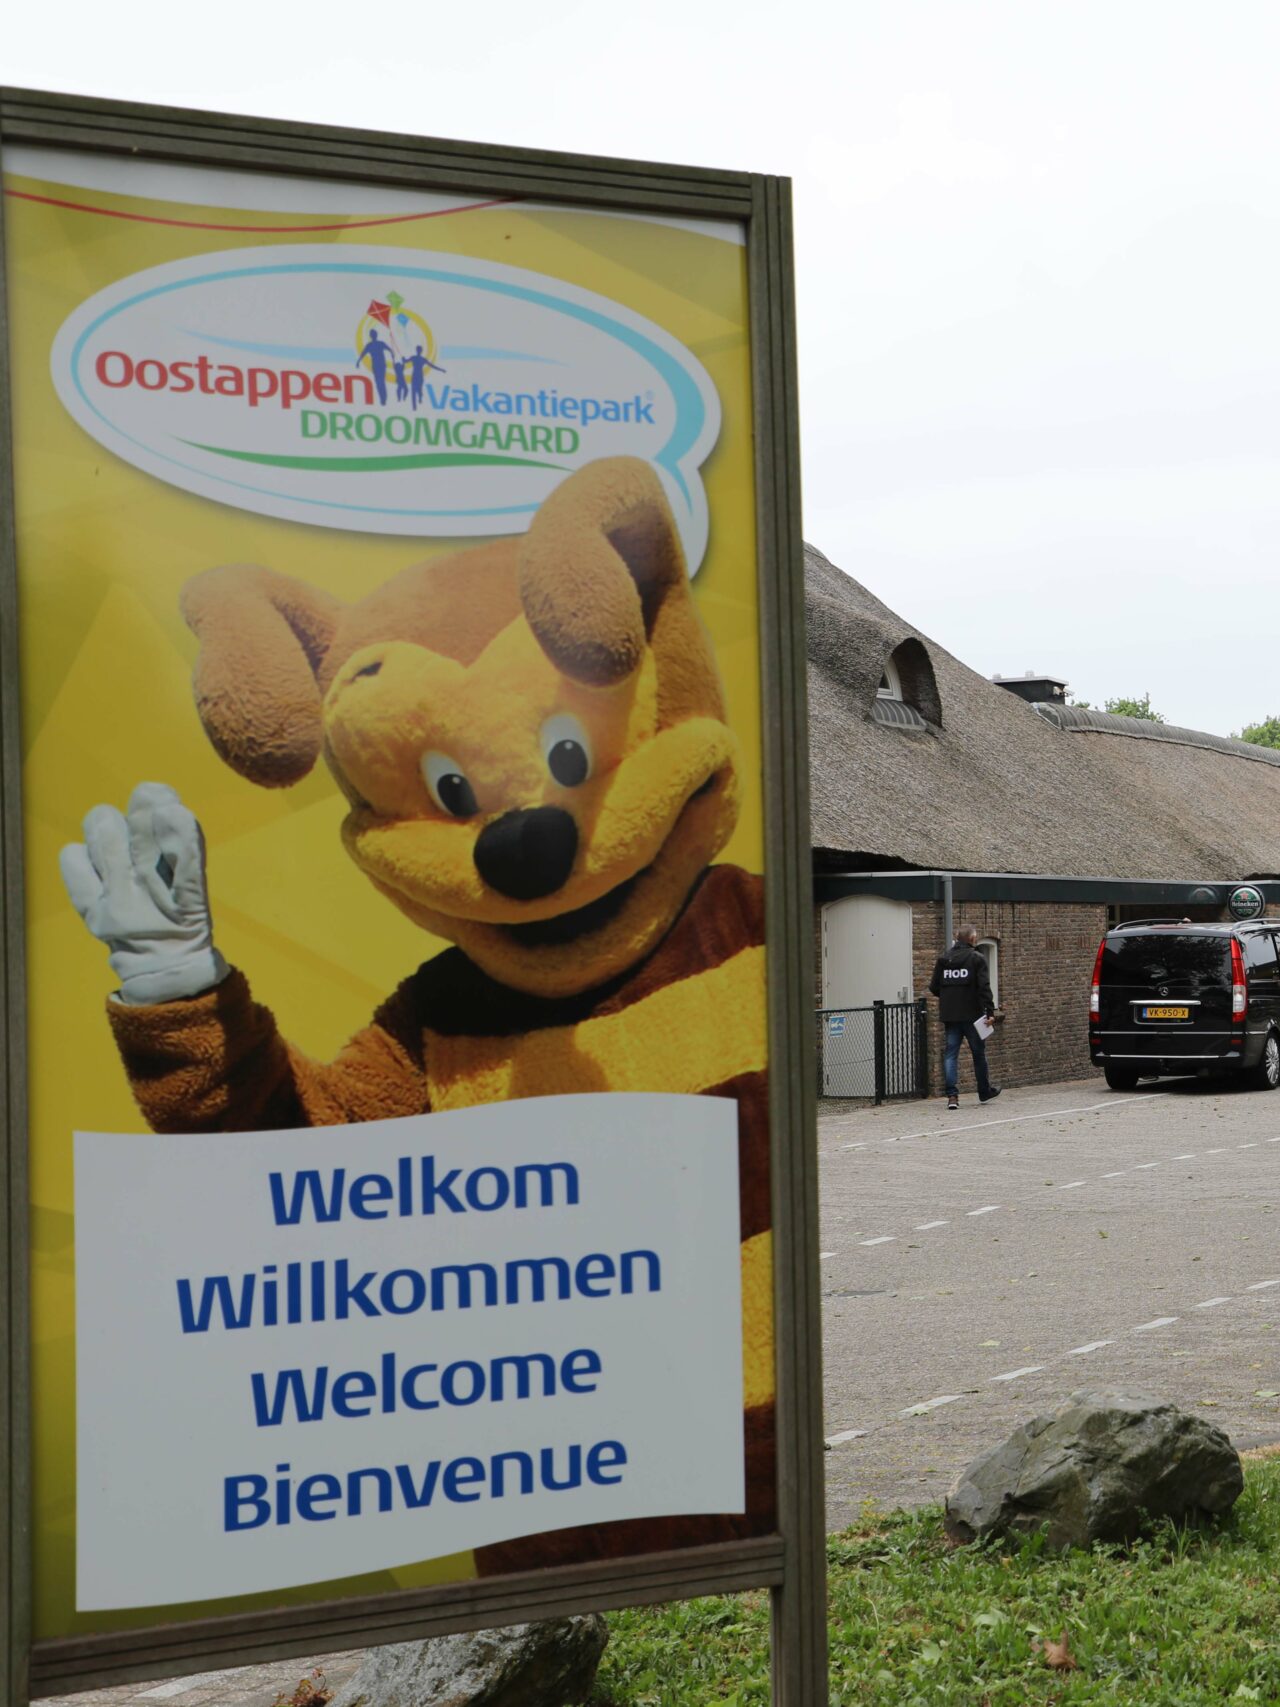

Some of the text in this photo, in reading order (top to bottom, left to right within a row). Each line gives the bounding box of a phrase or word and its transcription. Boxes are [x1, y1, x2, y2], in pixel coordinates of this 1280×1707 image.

[95, 349, 656, 426] Oostappen Vakantiepark
[300, 408, 580, 455] DROOMGAARD
[943, 968, 969, 979] FIOD
[1149, 1008, 1187, 1017] VK-950-X
[268, 1154, 580, 1226] Welkom
[175, 1248, 662, 1334] Willkommen
[250, 1347, 602, 1427] Welcome
[222, 1439, 628, 1532] Bienvenue
